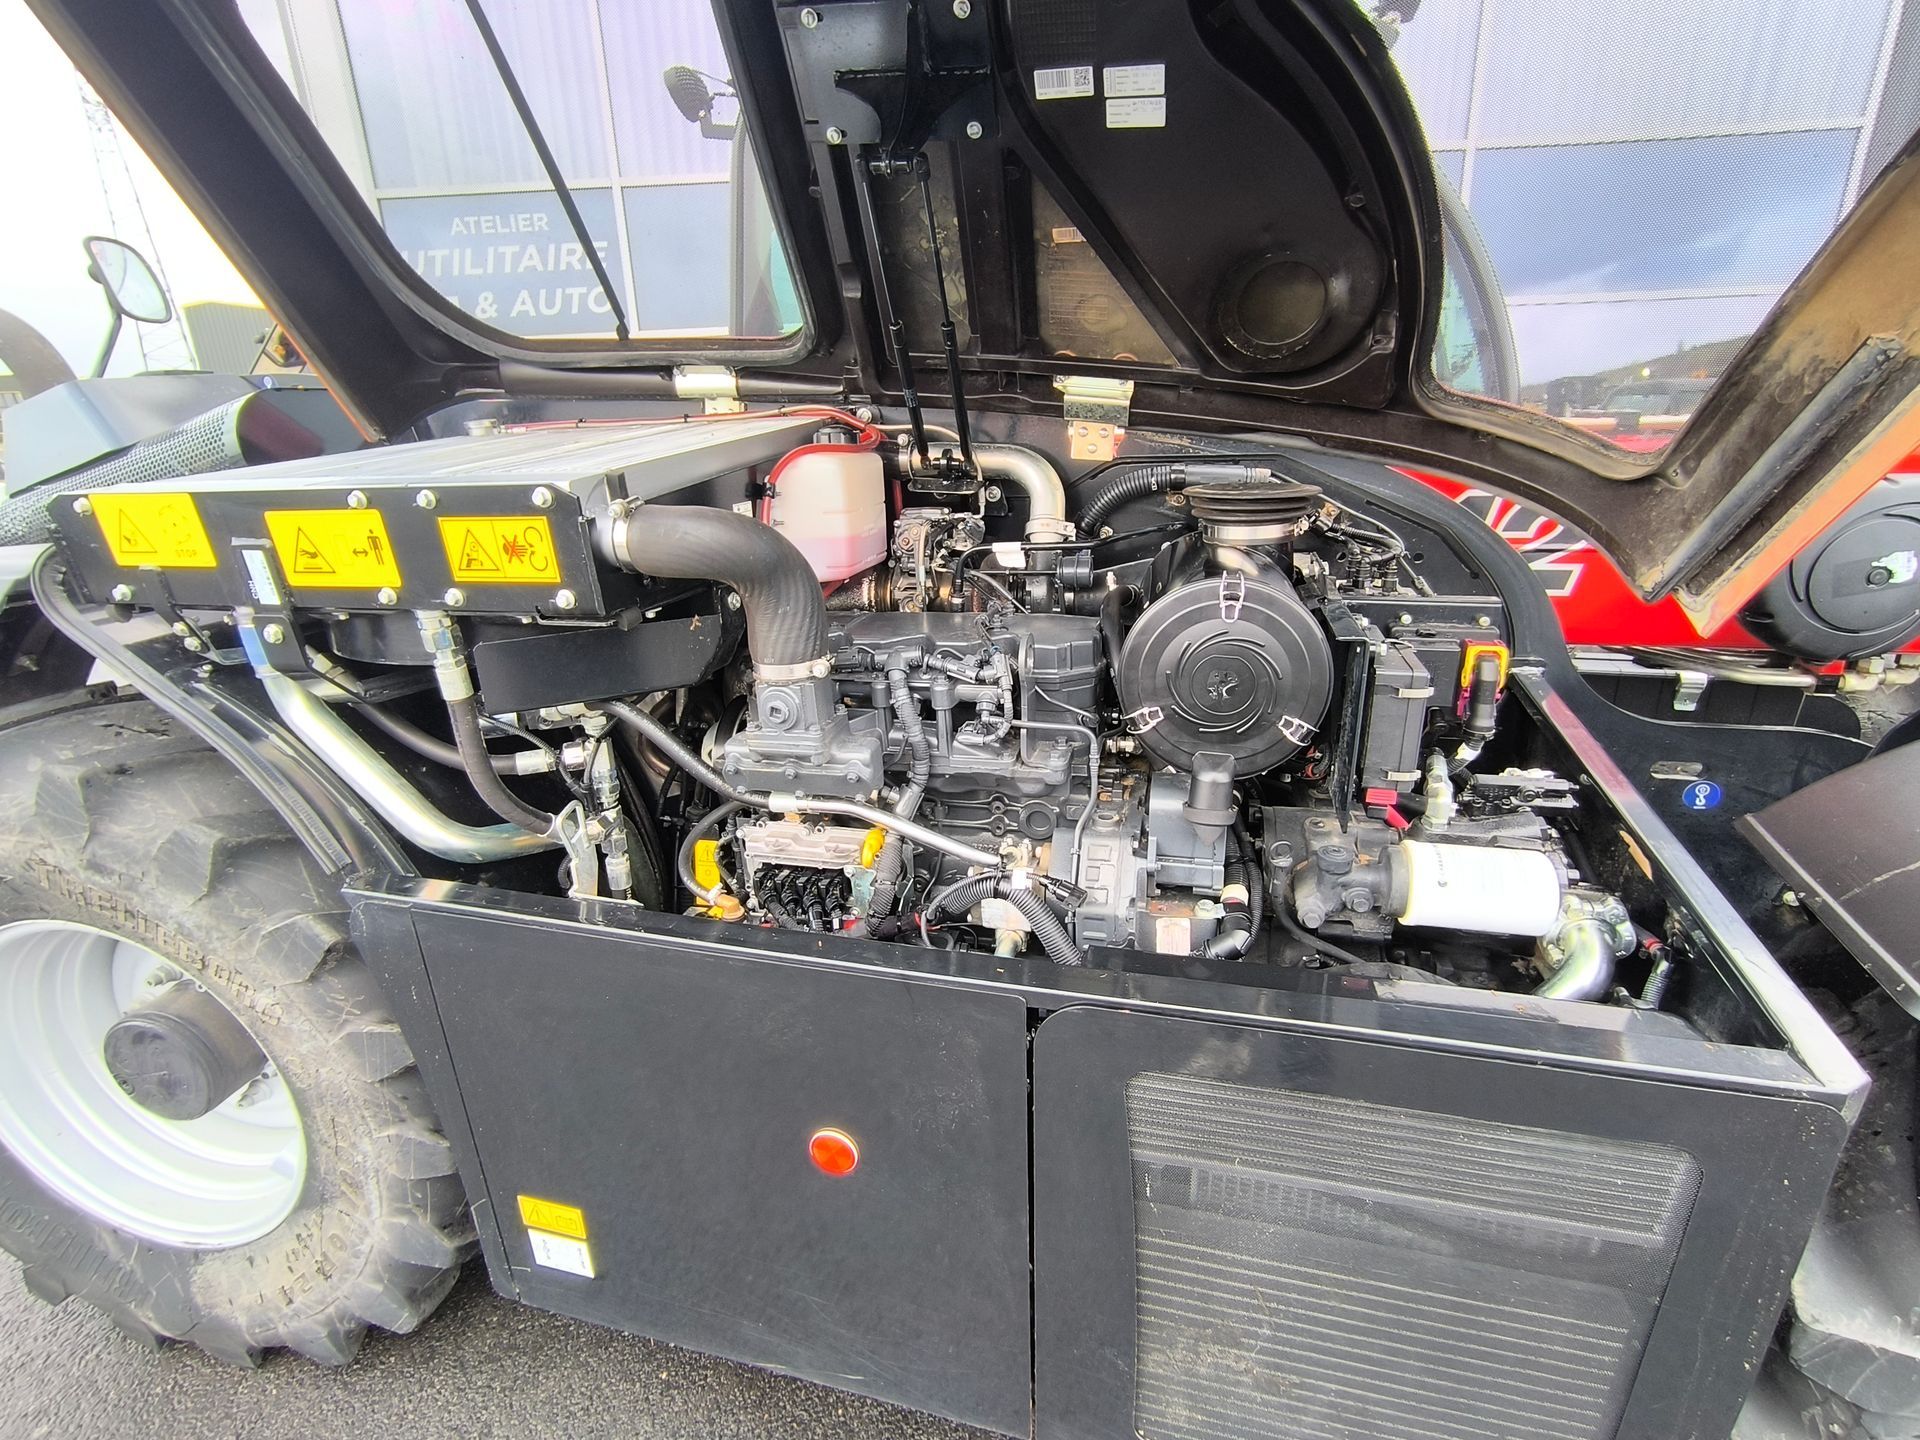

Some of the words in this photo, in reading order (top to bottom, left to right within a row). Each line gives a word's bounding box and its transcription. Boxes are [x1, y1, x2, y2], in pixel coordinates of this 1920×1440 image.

[451, 213, 549, 235] ATELIER
[474, 291, 498, 319] &
[509, 286, 612, 317] AUTO
